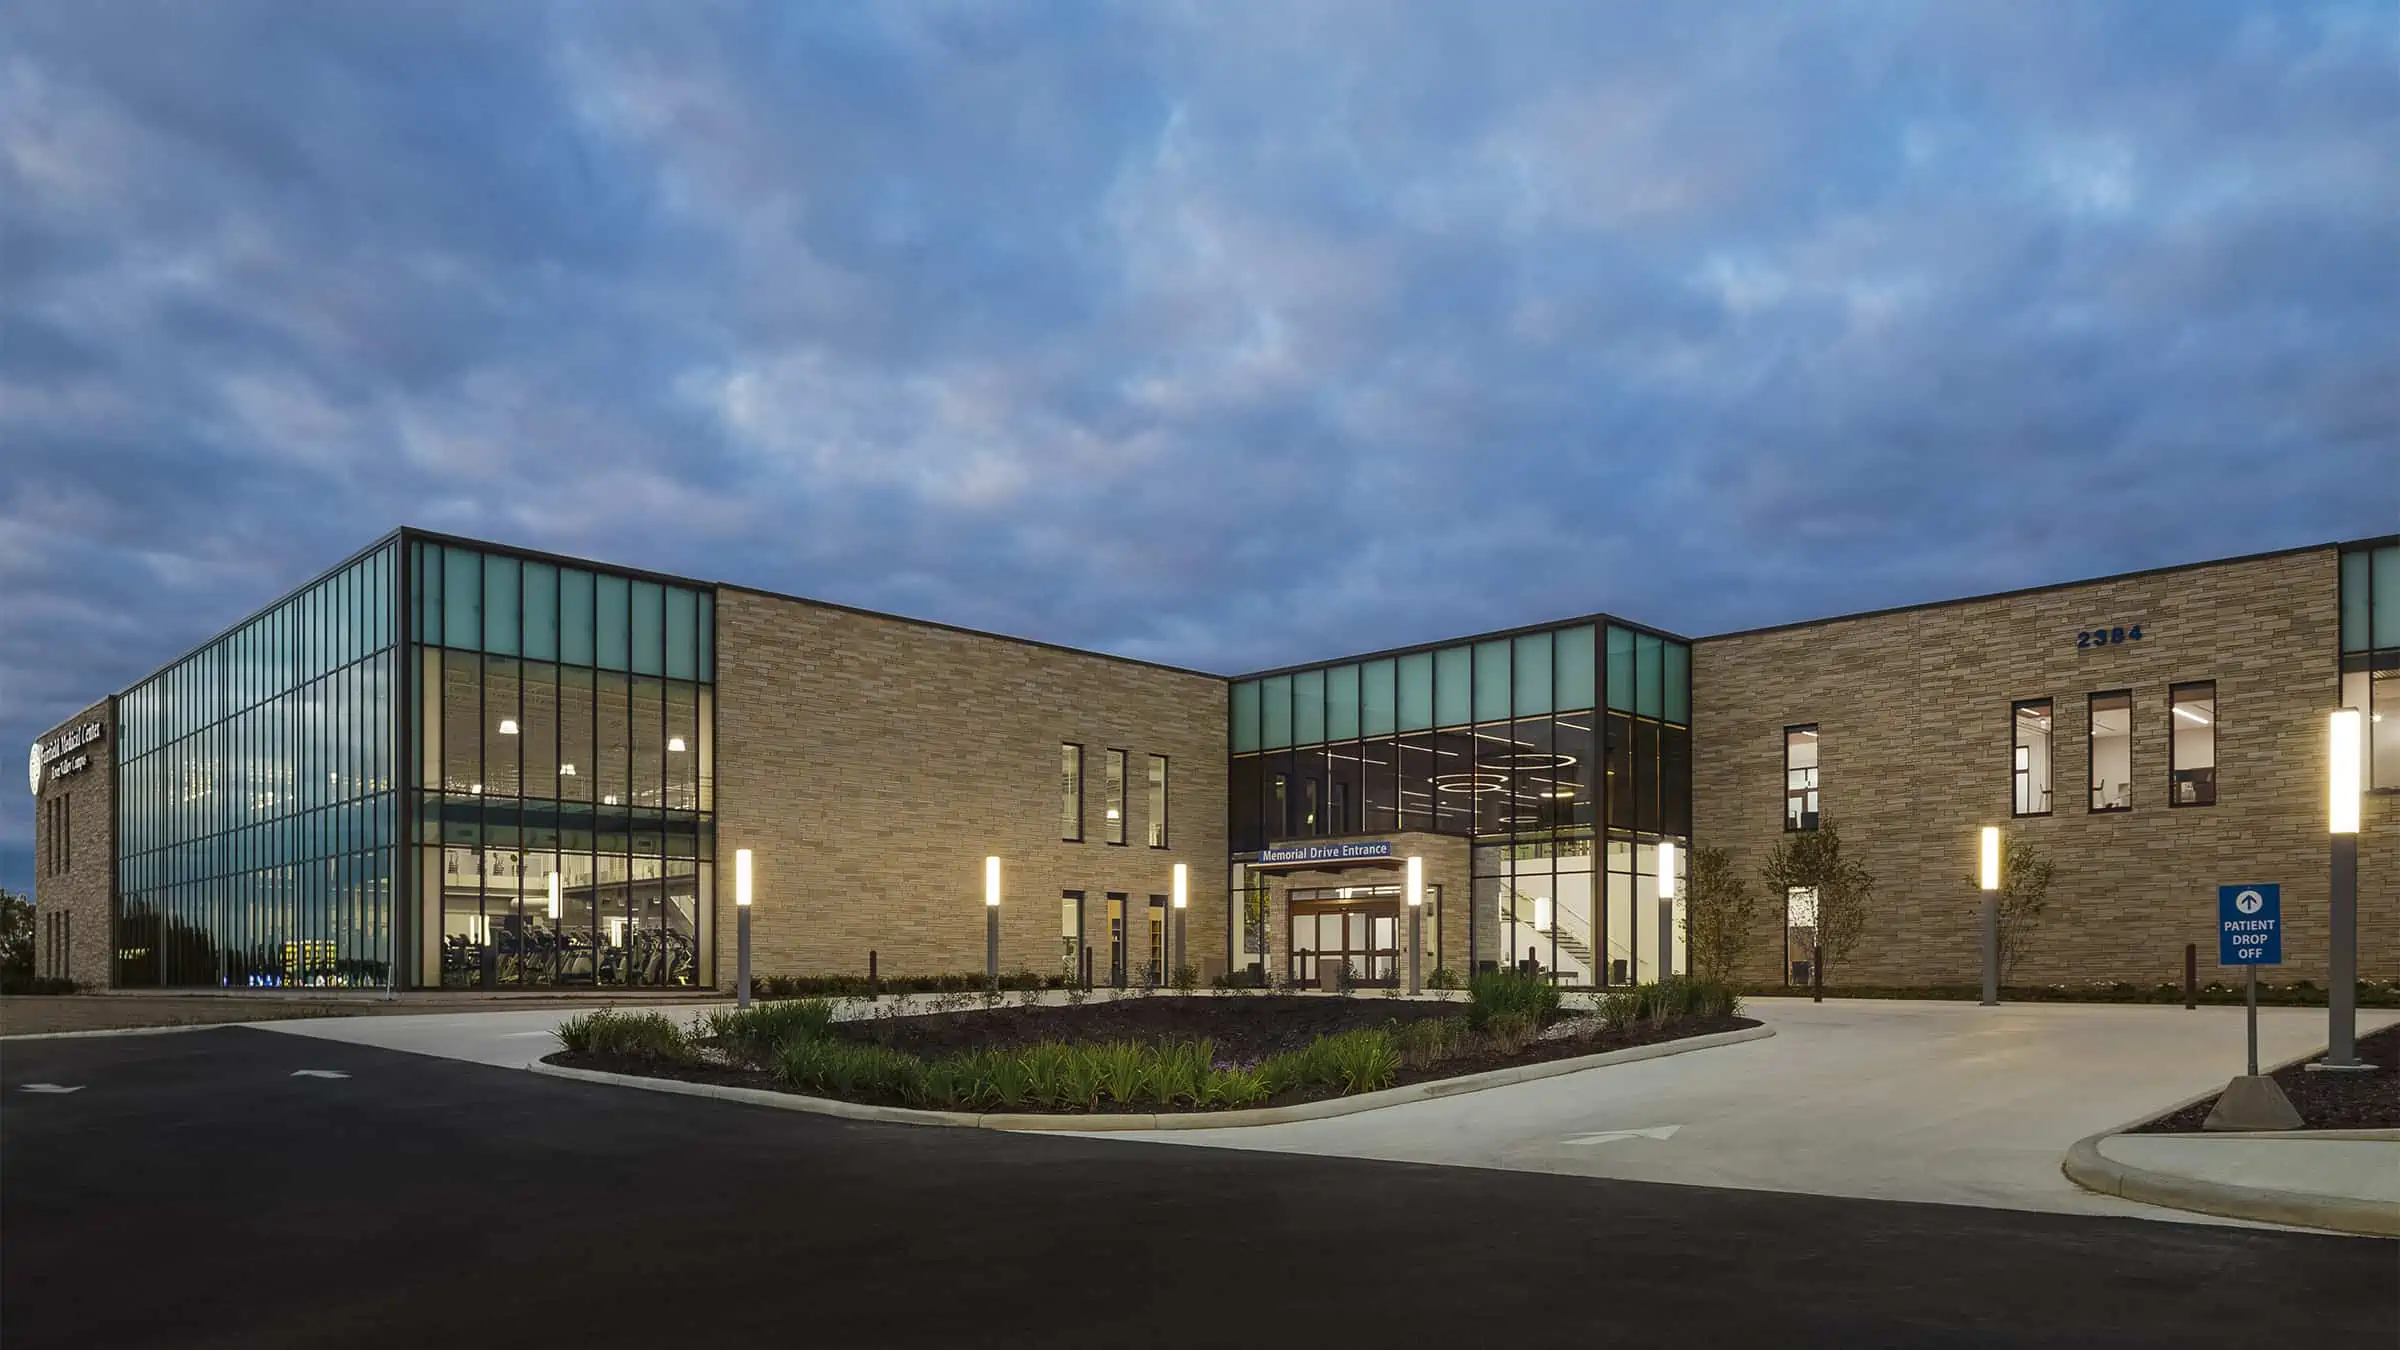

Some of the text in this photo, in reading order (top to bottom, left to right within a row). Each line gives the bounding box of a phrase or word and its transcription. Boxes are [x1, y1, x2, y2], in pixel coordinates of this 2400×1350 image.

[2076, 624, 2142, 648] 2384
[61, 726, 81, 755] Medical
[82, 723, 100, 744] Center
[1263, 843, 1387, 861] Memorial Drive Entrance
[2224, 920, 2275, 931] PATIENT
[2232, 934, 2268, 945] DROP
[2238, 948, 2263, 959] OFF
